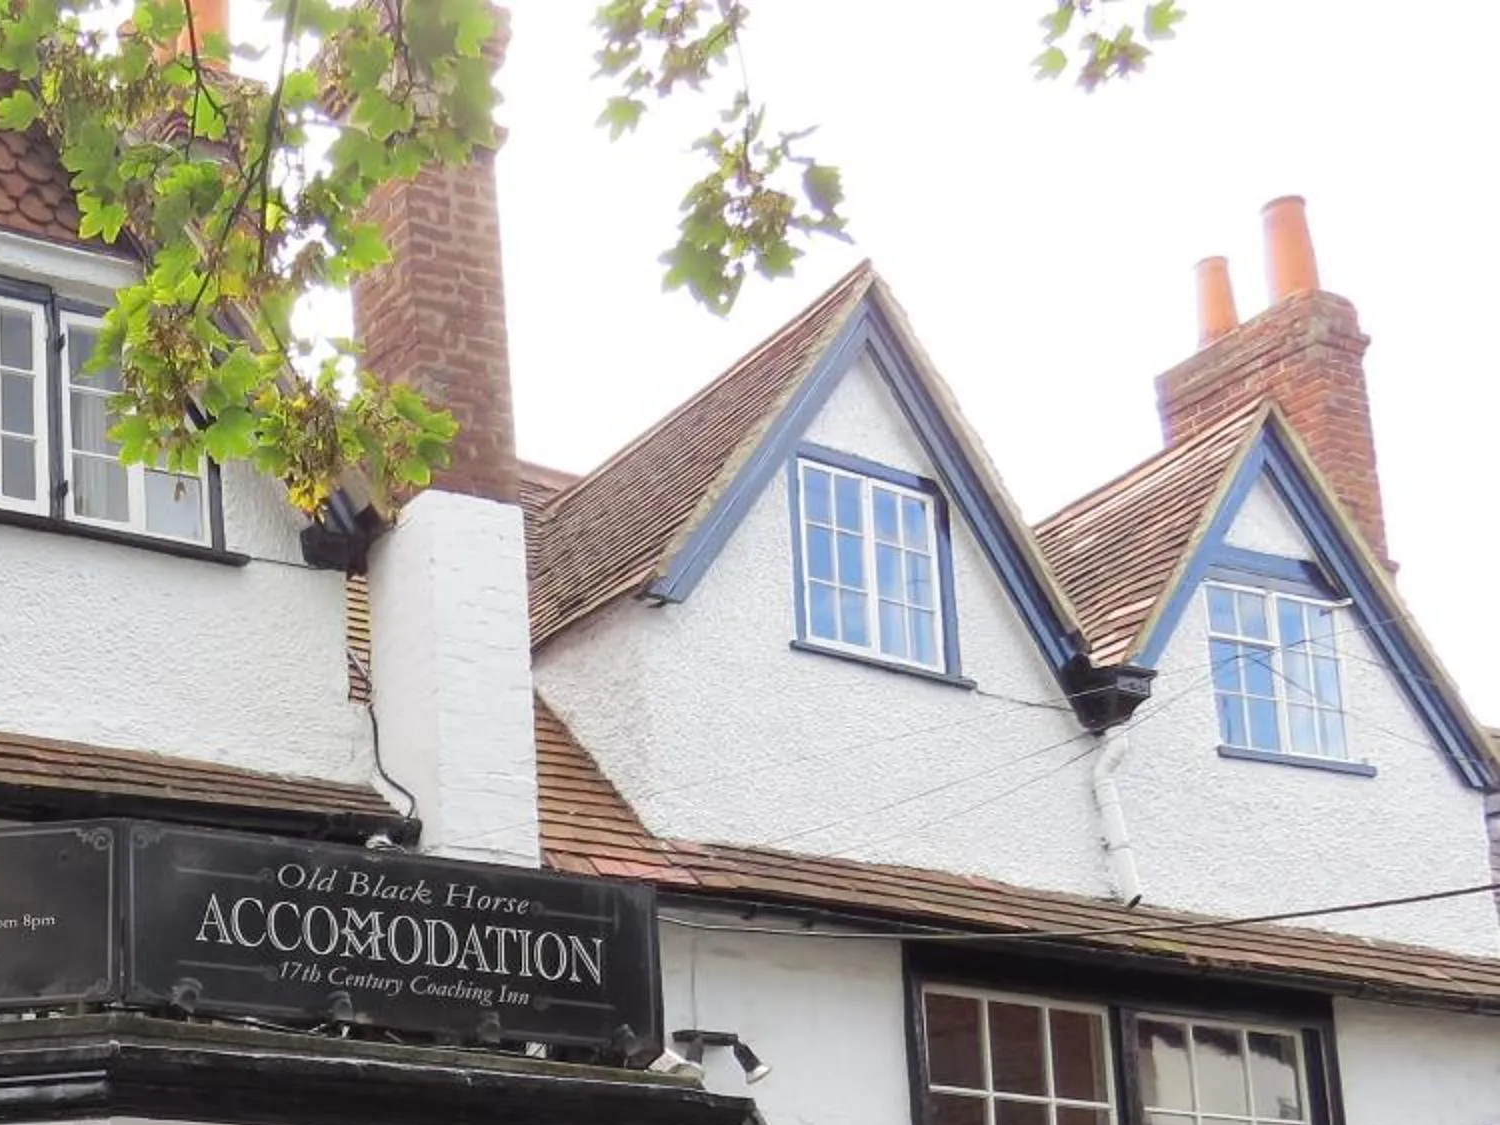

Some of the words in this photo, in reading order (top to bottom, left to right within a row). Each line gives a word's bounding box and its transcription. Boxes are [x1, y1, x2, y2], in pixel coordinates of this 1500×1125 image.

[277, 863, 338, 892] Old
[346, 871, 432, 904] Black
[445, 883, 530, 914] Horse
[23, 915, 56, 930] 8pm
[279, 961, 322, 984] 17th
[328, 966, 401, 997] Century
[410, 975, 493, 1006] Coaching
[500, 985, 530, 1005] Inn
